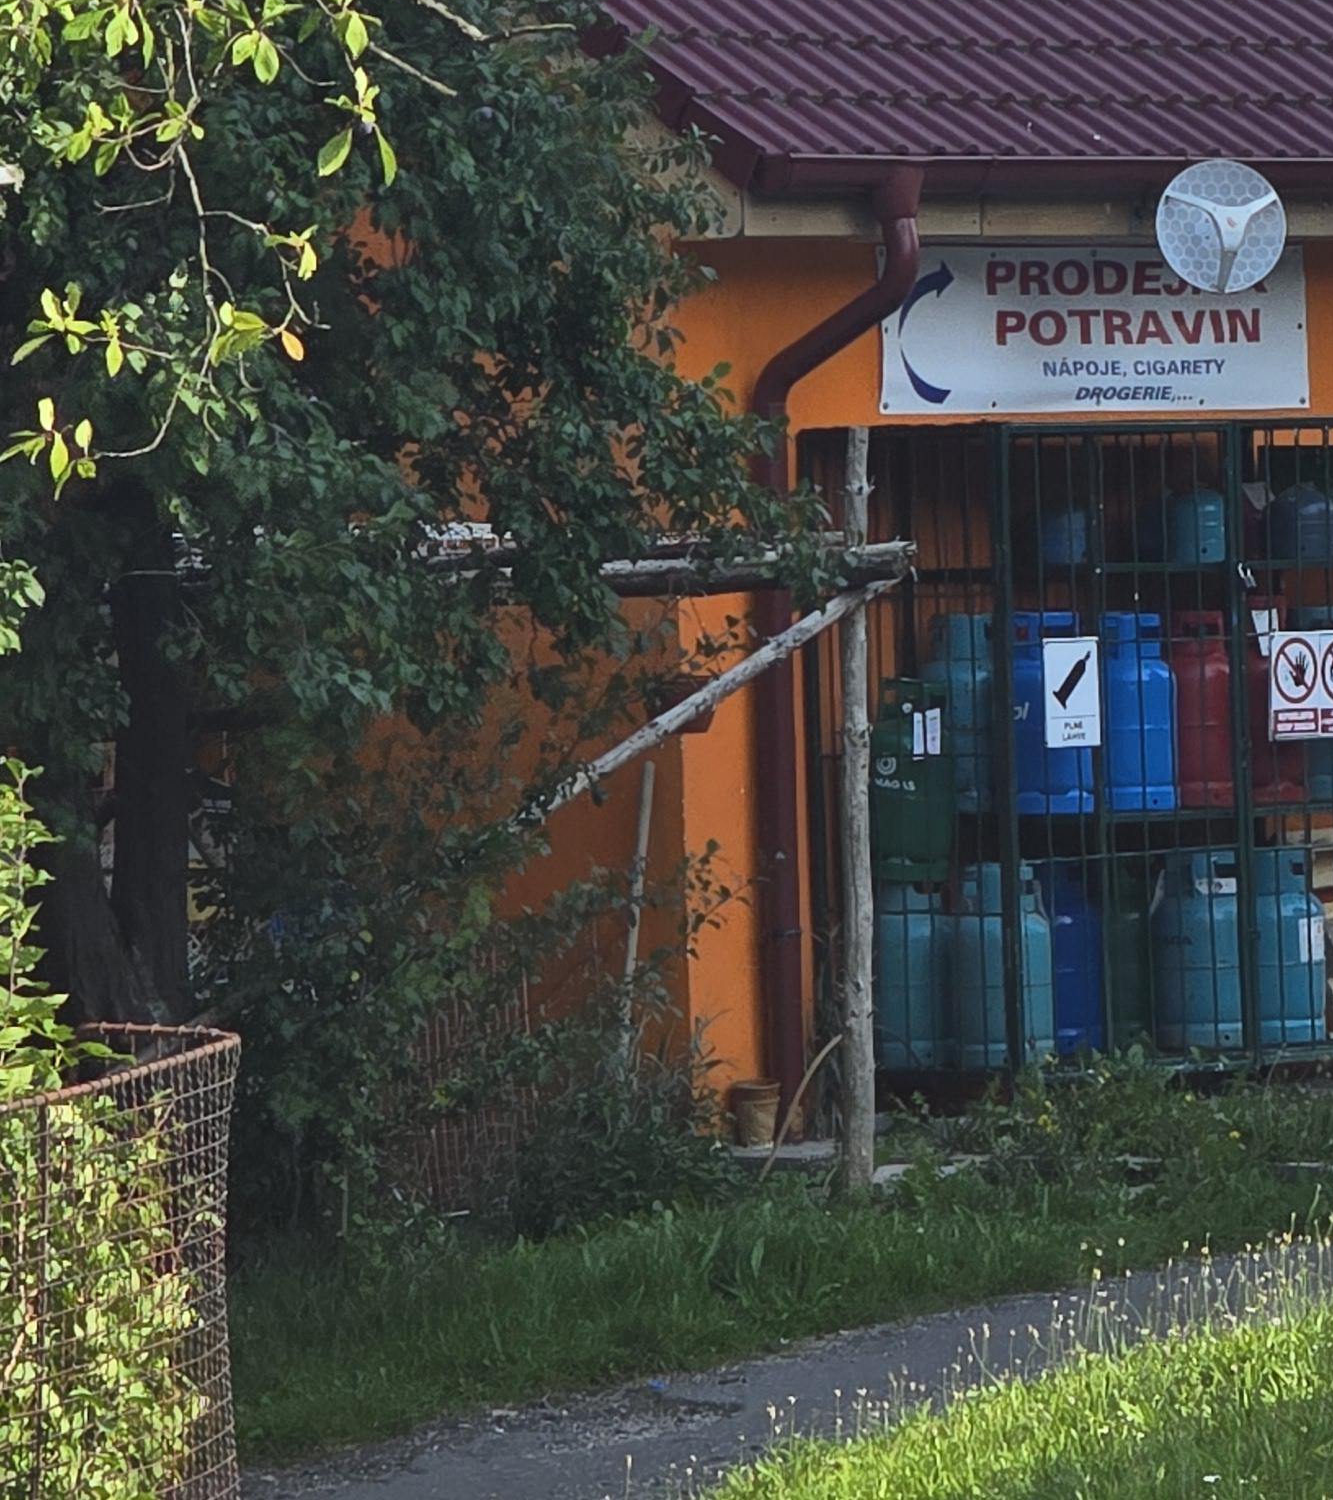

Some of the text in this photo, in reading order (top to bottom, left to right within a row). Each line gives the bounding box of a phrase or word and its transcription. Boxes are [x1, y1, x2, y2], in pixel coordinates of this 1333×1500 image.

[986, 260, 1268, 297] PRODEJ
[995, 307, 1261, 346] POTRAVIN
[1042, 357, 1226, 377] NÁPOJE, CIGARETY
